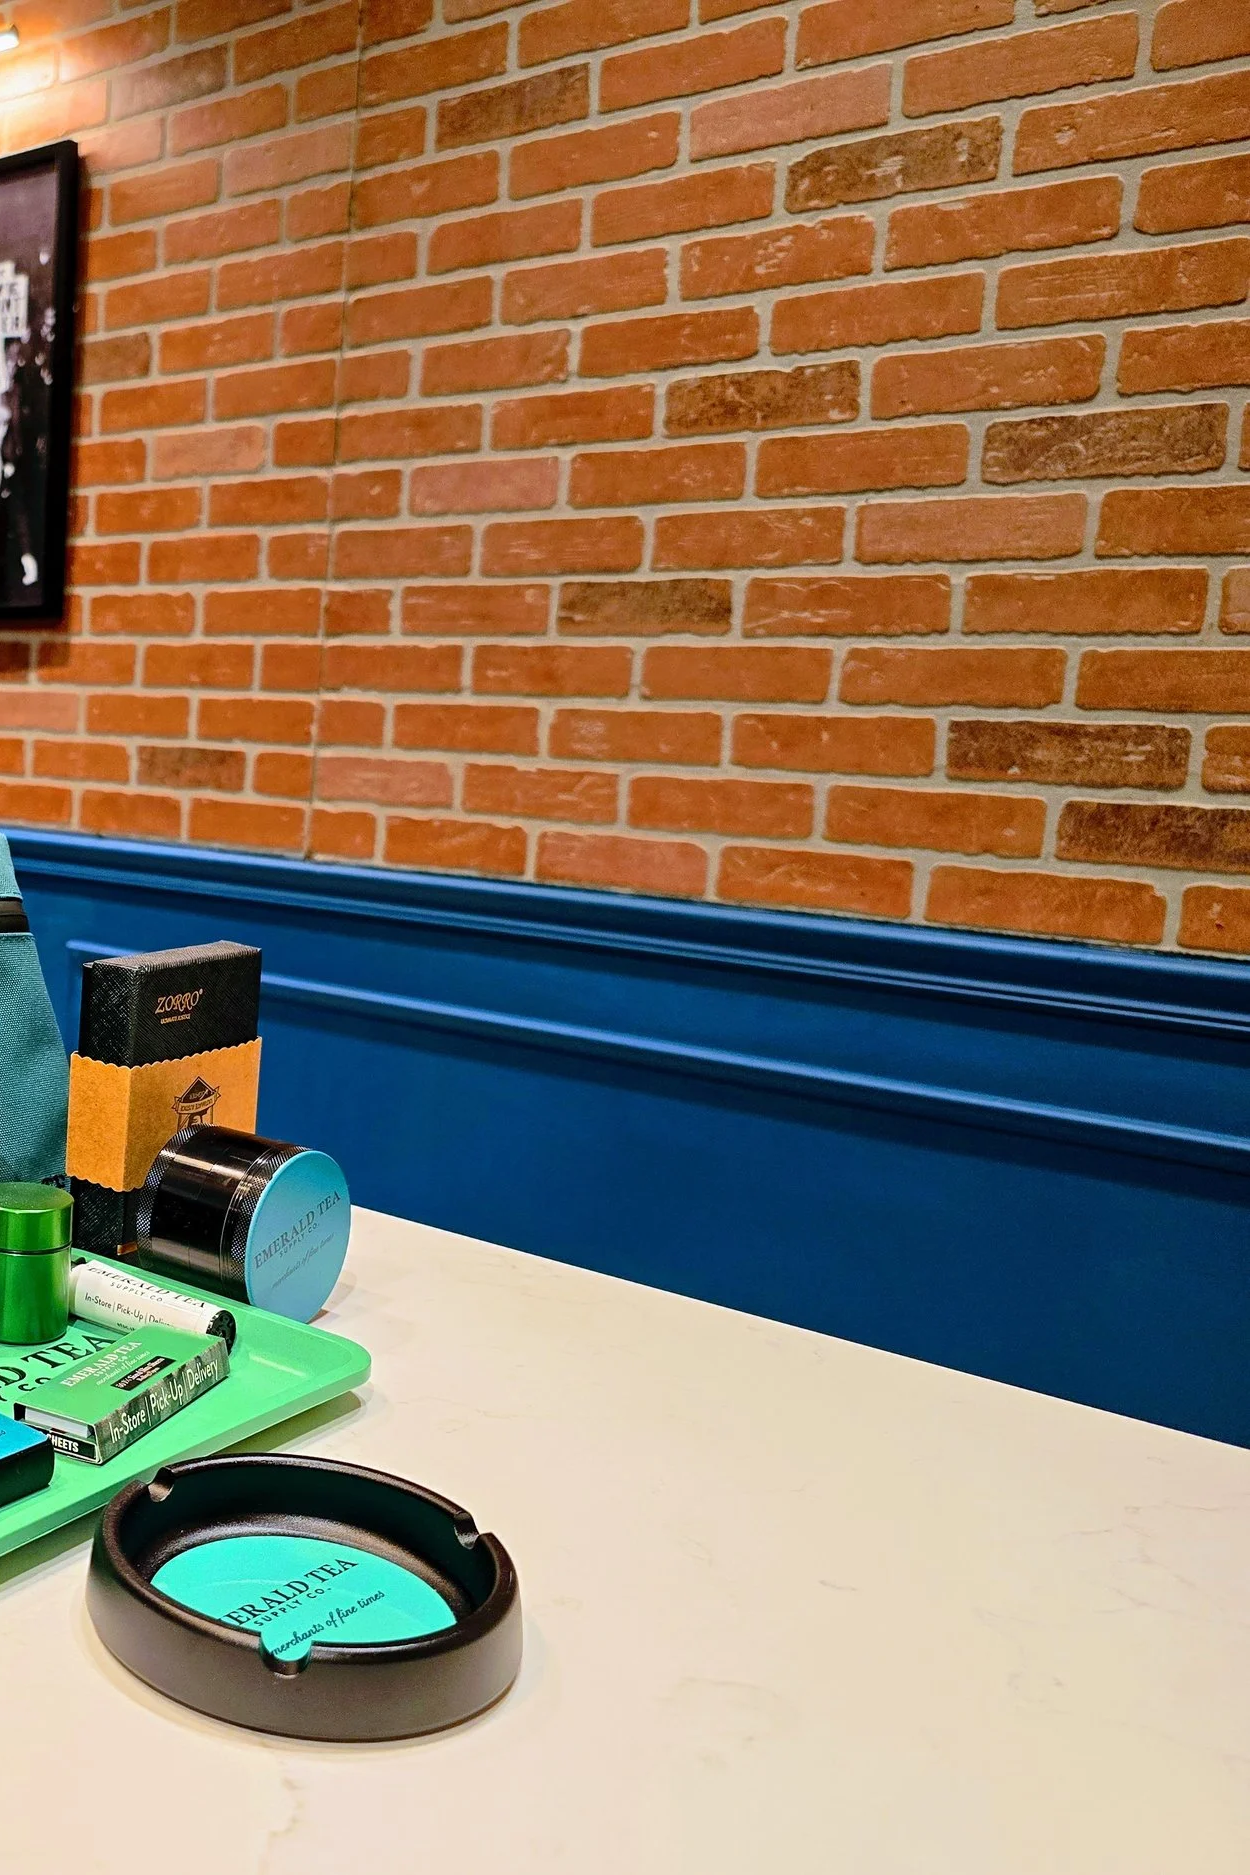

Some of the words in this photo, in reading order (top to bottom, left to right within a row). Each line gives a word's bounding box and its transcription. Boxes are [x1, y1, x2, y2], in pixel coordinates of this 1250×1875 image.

[154, 990, 200, 1015] ZORRO
[253, 1211, 315, 1269] EMERALD
[316, 1191, 341, 1217] TEA
[84, 1291, 112, 1310] In-Store
[116, 1303, 144, 1323] Pick-Up
[110, 1281, 146, 1297] SUPPLY
[20, 1334, 118, 1369] TEA
[59, 1353, 120, 1388] EMERALD
[113, 1341, 143, 1355] TEA
[108, 1408, 146, 1444] In-Store
[149, 1378, 184, 1416] Pick-Up
[186, 1358, 219, 1392] Delivery
[218, 1580, 310, 1626] ERALD
[303, 1558, 359, 1583] TEA
[253, 1600, 303, 1627] SUPPLY
[270, 1623, 325, 1656] merchants
[325, 1612, 339, 1628] of
[336, 1605, 358, 1624] fine
[356, 1590, 386, 1609] times
